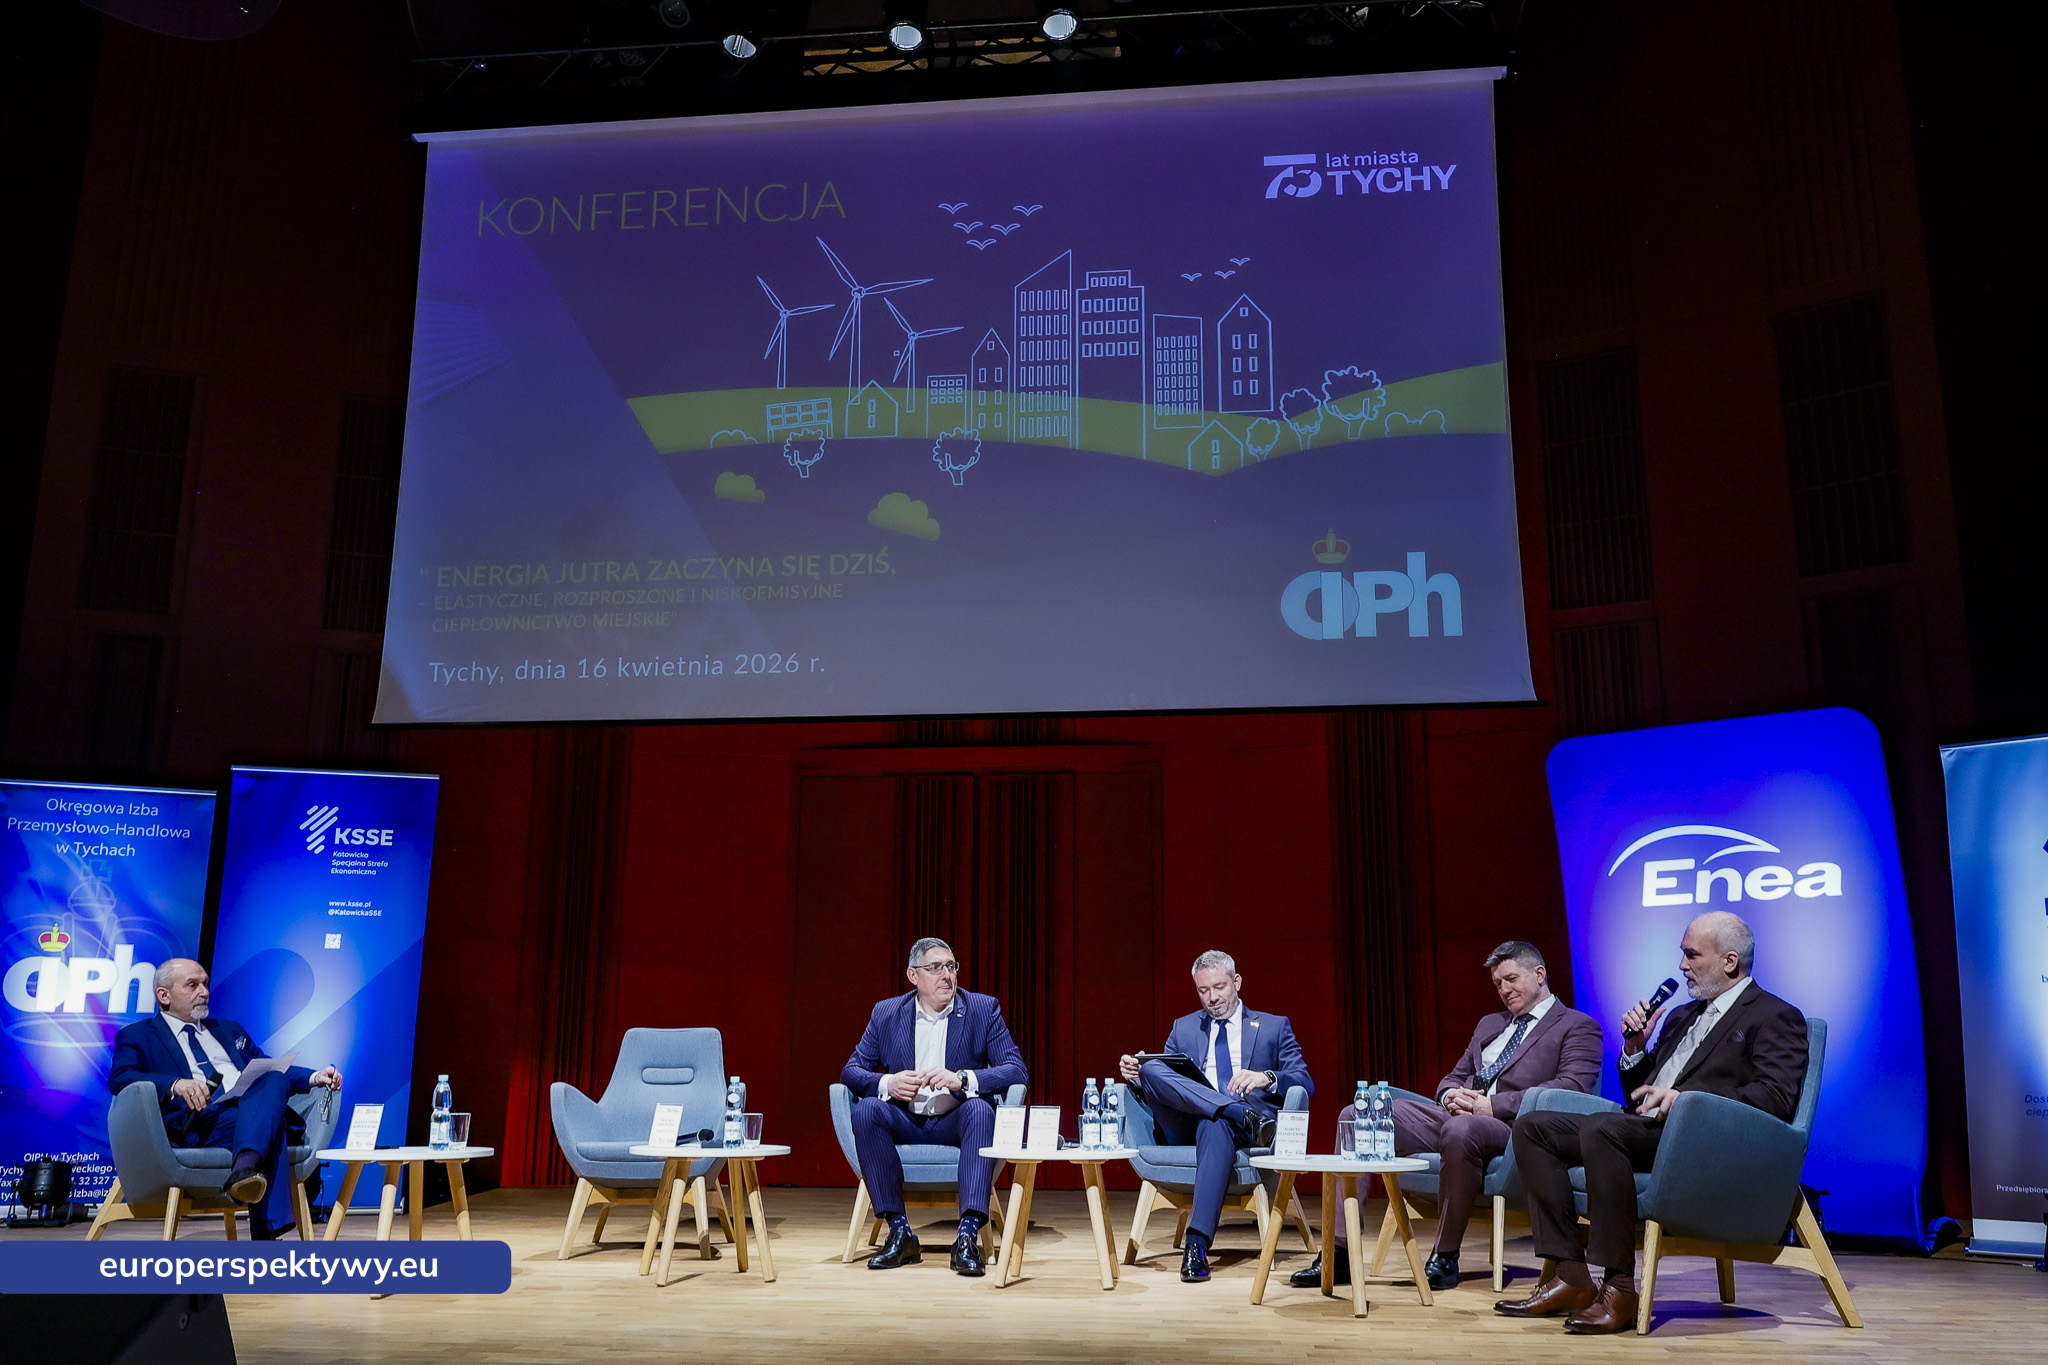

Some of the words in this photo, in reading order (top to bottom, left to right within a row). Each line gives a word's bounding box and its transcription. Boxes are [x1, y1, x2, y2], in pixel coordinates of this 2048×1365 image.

[1326, 152, 1350, 167] lat
[1354, 151, 1419, 166] miasta
[1326, 164, 1457, 196] TYCHY
[478, 180, 846, 237] KONFERENCJA
[437, 563, 550, 588] ENERGIA
[556, 560, 640, 584] JUTRA
[646, 556, 775, 582] ZACZYNA
[782, 554, 821, 580] SIĘ
[830, 547, 896, 577] DZIŚ,
[434, 592, 547, 610] ELASTYCZNE,
[553, 588, 685, 607] ROZPROSZONE
[702, 583, 843, 602] NISKOEMISYJNE
[432, 613, 587, 633] CIEPŁOWNICTWO
[429, 661, 505, 686] Tychy,
[515, 658, 567, 680] dnia
[578, 657, 607, 679] 16
[618, 654, 723, 678] kwietnia
[734, 652, 800, 675] 2026
[810, 656, 825, 673] r.
[46, 798, 124, 816] Okręgowa
[129, 803, 159, 816] Izba
[7, 817, 191, 839] Przemysłowo-Handlowa
[334, 827, 394, 846] KSSE
[56, 843, 70, 854] w
[73, 841, 136, 858] Tychach
[330, 868, 377, 876] Ekonomiczna
[331, 859, 366, 868] Specjalna
[367, 860, 389, 868] Strefa
[1641, 858, 1843, 907] Enea
[328, 900, 371, 908] www.ksse.pl
[328, 908, 382, 917] @KatowickaSSE
[2024, 1094, 2048, 1104] Dost
[2026, 1108, 2048, 1118] ciep
[51, 1154, 60, 1162] w
[61, 1152, 100, 1162] Tychach
[78, 1176, 90, 1186] 32
[92, 1176, 110, 1185] 327
[1996, 1184, 2048, 1194] Przedsiębiors
